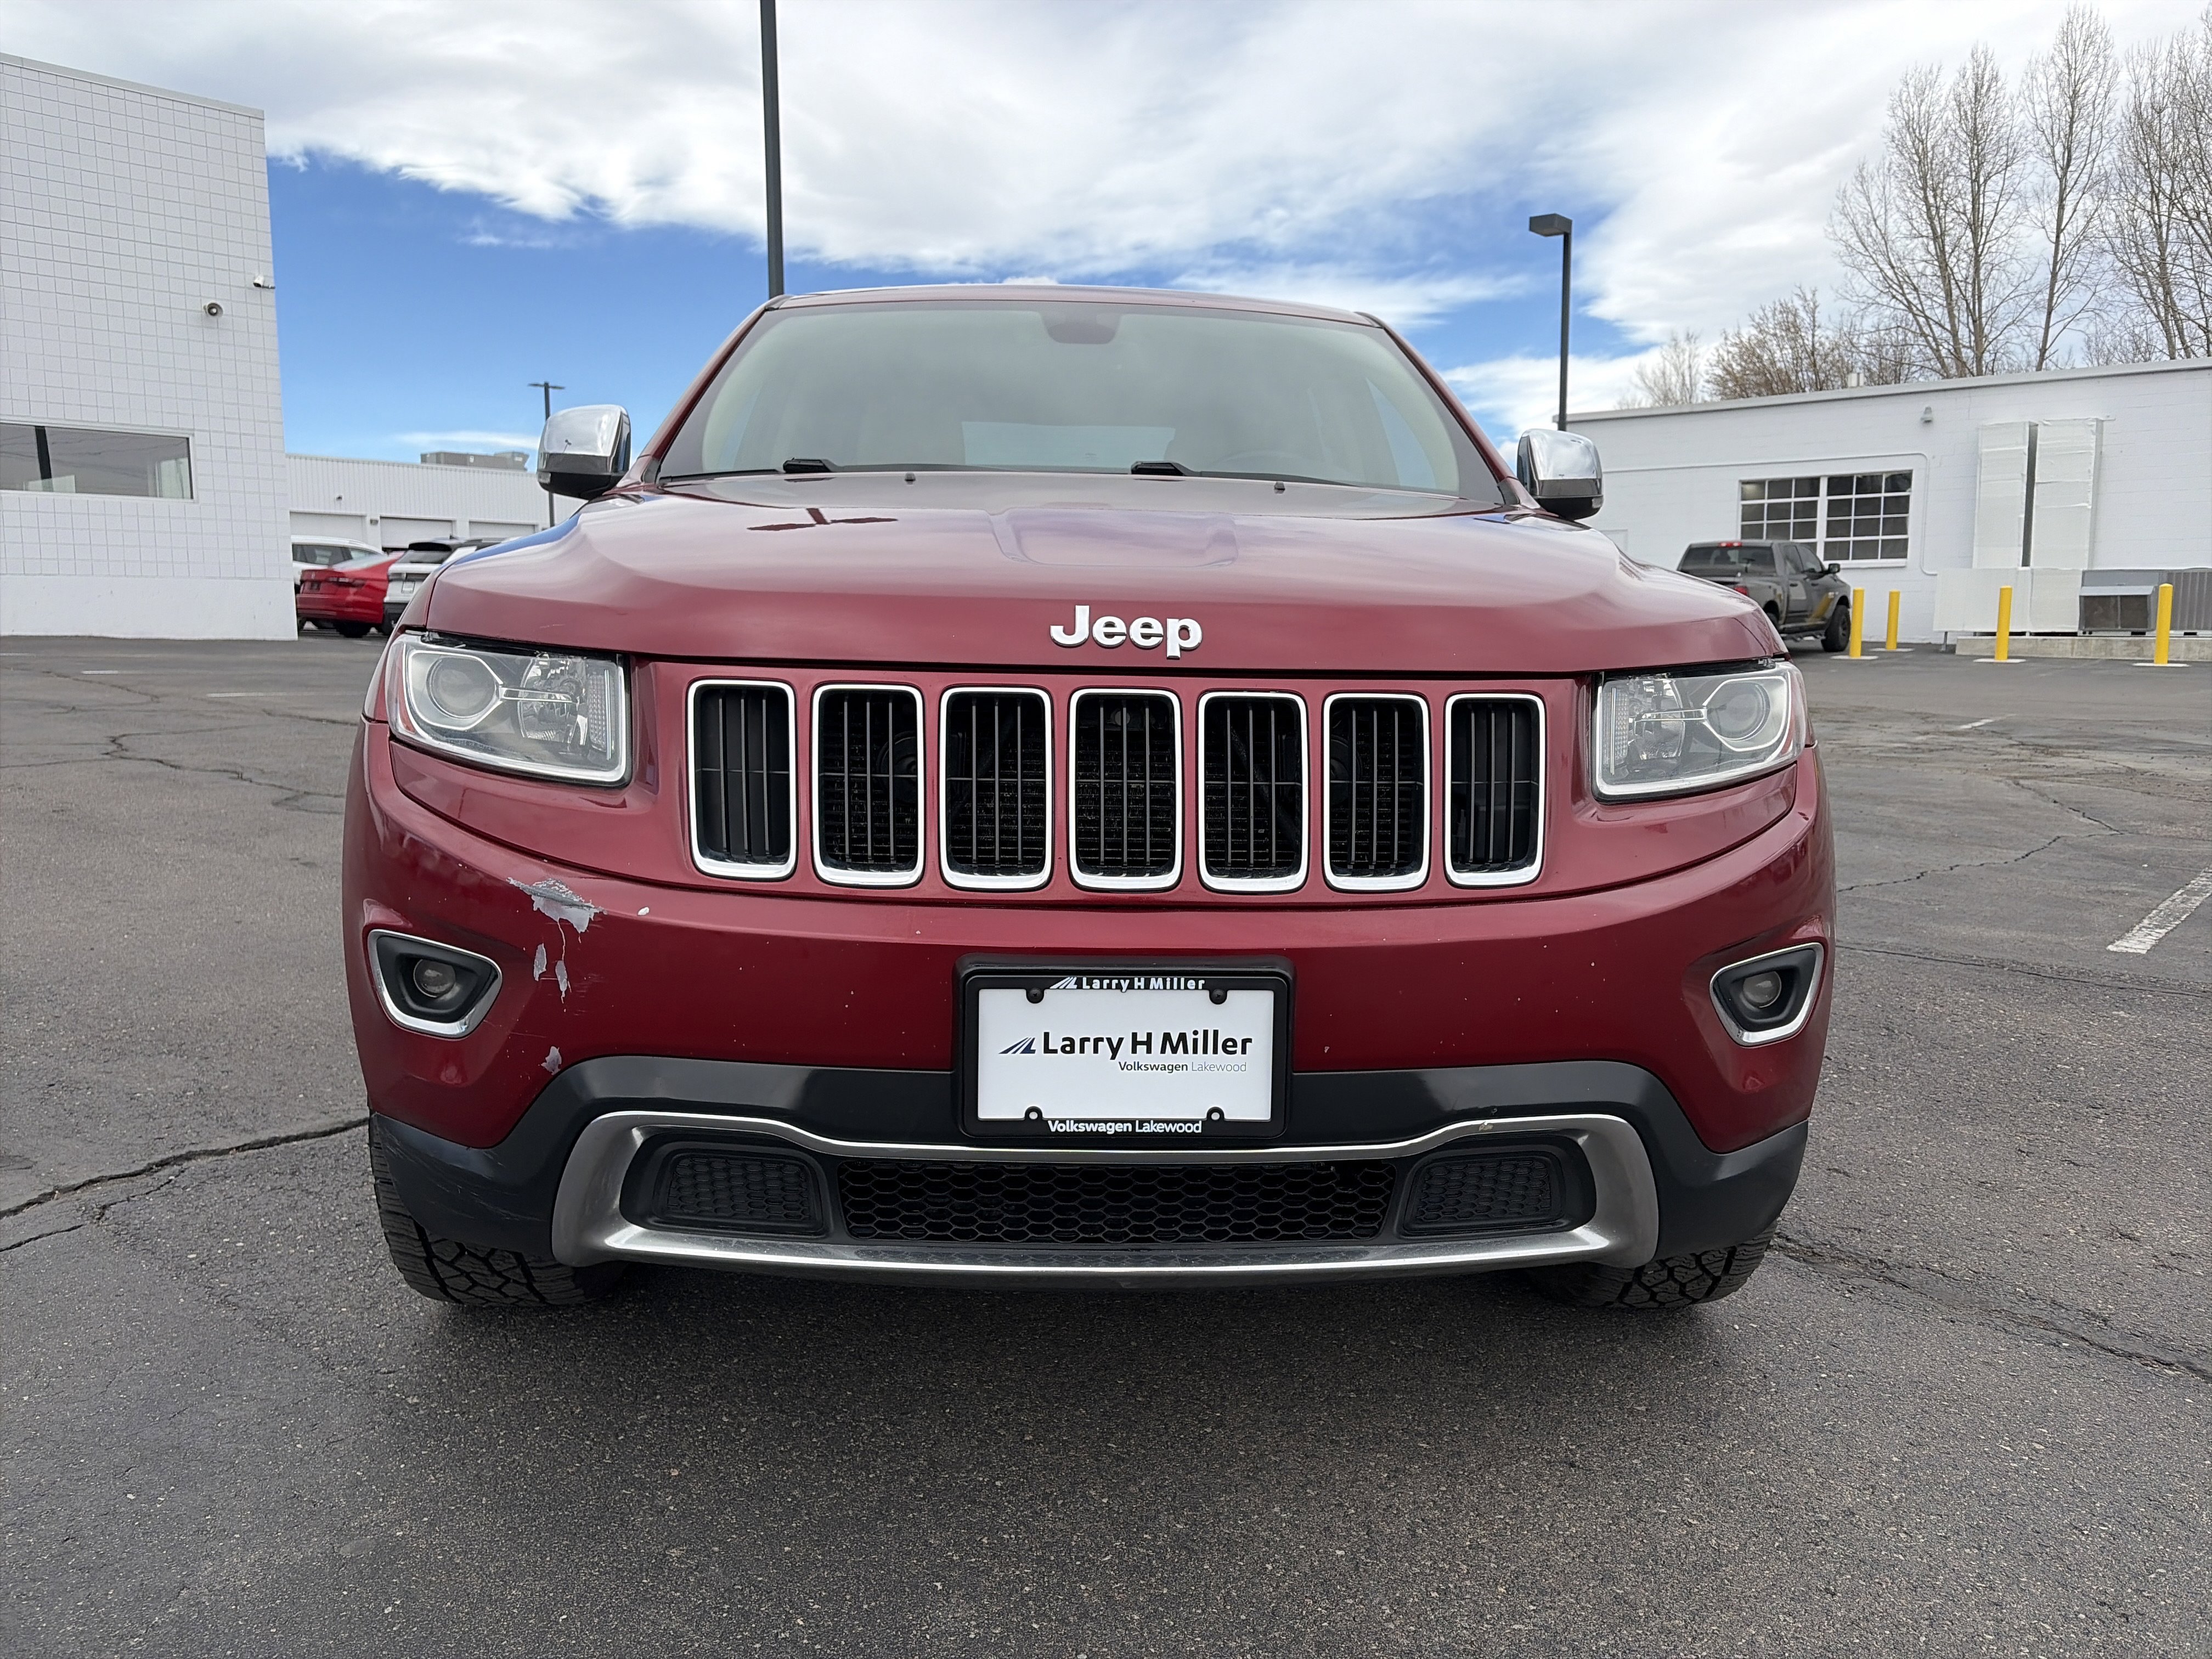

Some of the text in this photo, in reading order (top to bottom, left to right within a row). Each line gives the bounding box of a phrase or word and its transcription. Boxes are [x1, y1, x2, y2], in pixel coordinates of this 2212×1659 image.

[1050, 605, 1203, 660] Jeep
[1082, 977, 1205, 992] Larry H Miller
[1043, 1029, 1252, 1060] Larry H Miller
[1118, 1061, 1246, 1073] Volkswagen Lakewood
[1047, 1120, 1202, 1135] Volkswagen Lakewood
